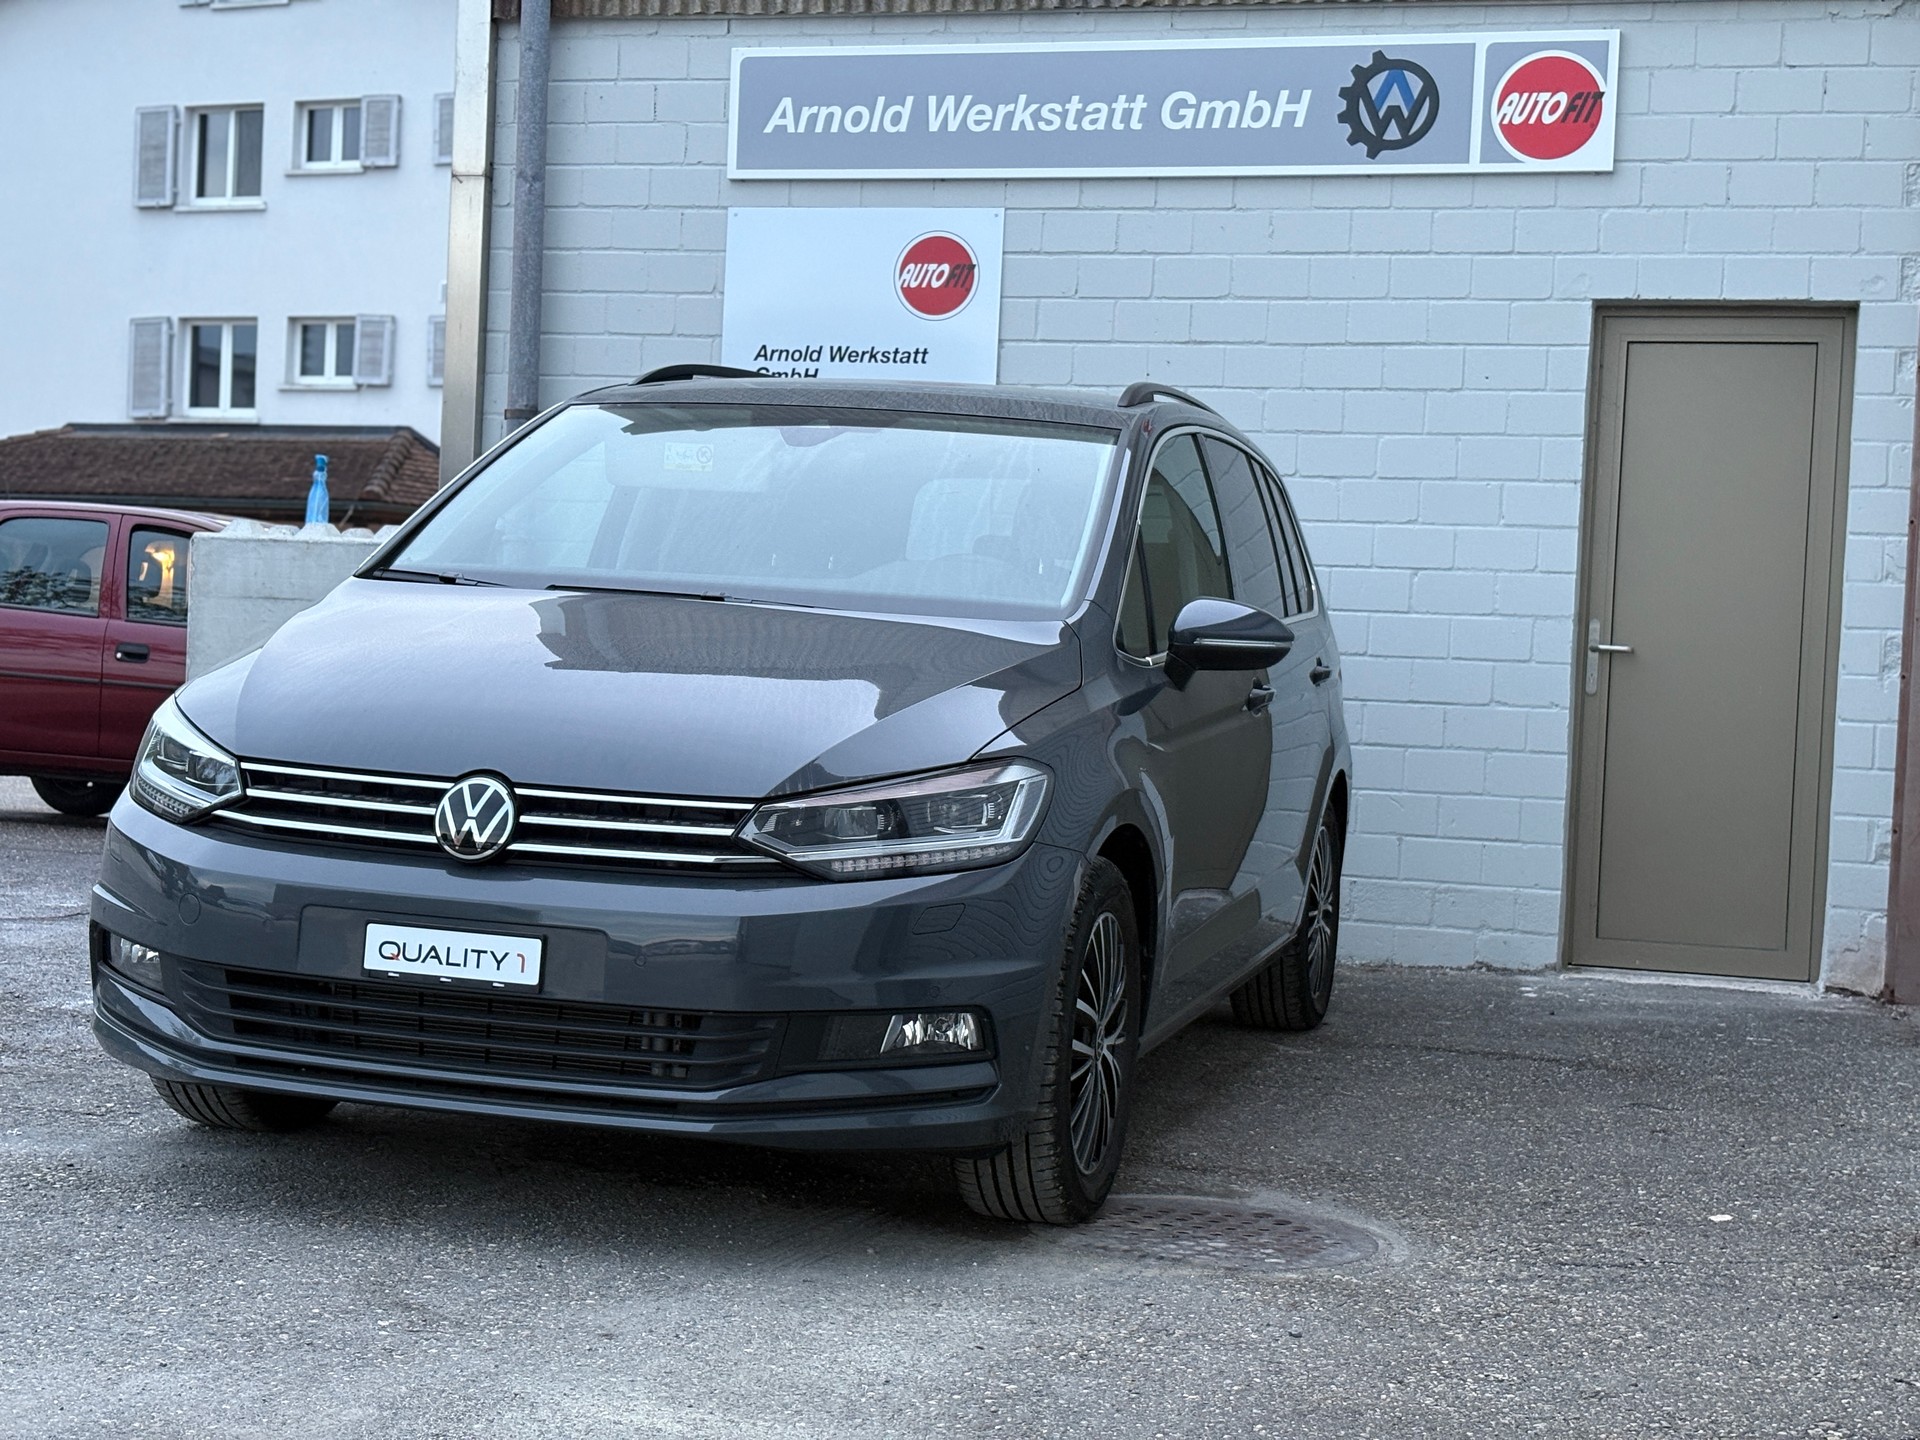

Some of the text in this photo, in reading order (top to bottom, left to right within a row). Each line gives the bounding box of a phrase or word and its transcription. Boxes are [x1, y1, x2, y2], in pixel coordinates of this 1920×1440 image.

[763, 89, 1312, 133] Arnold Werkstatt GmbH
[754, 344, 928, 364] Arnold Werkstatt
[378, 940, 526, 973] QUALITY 1
